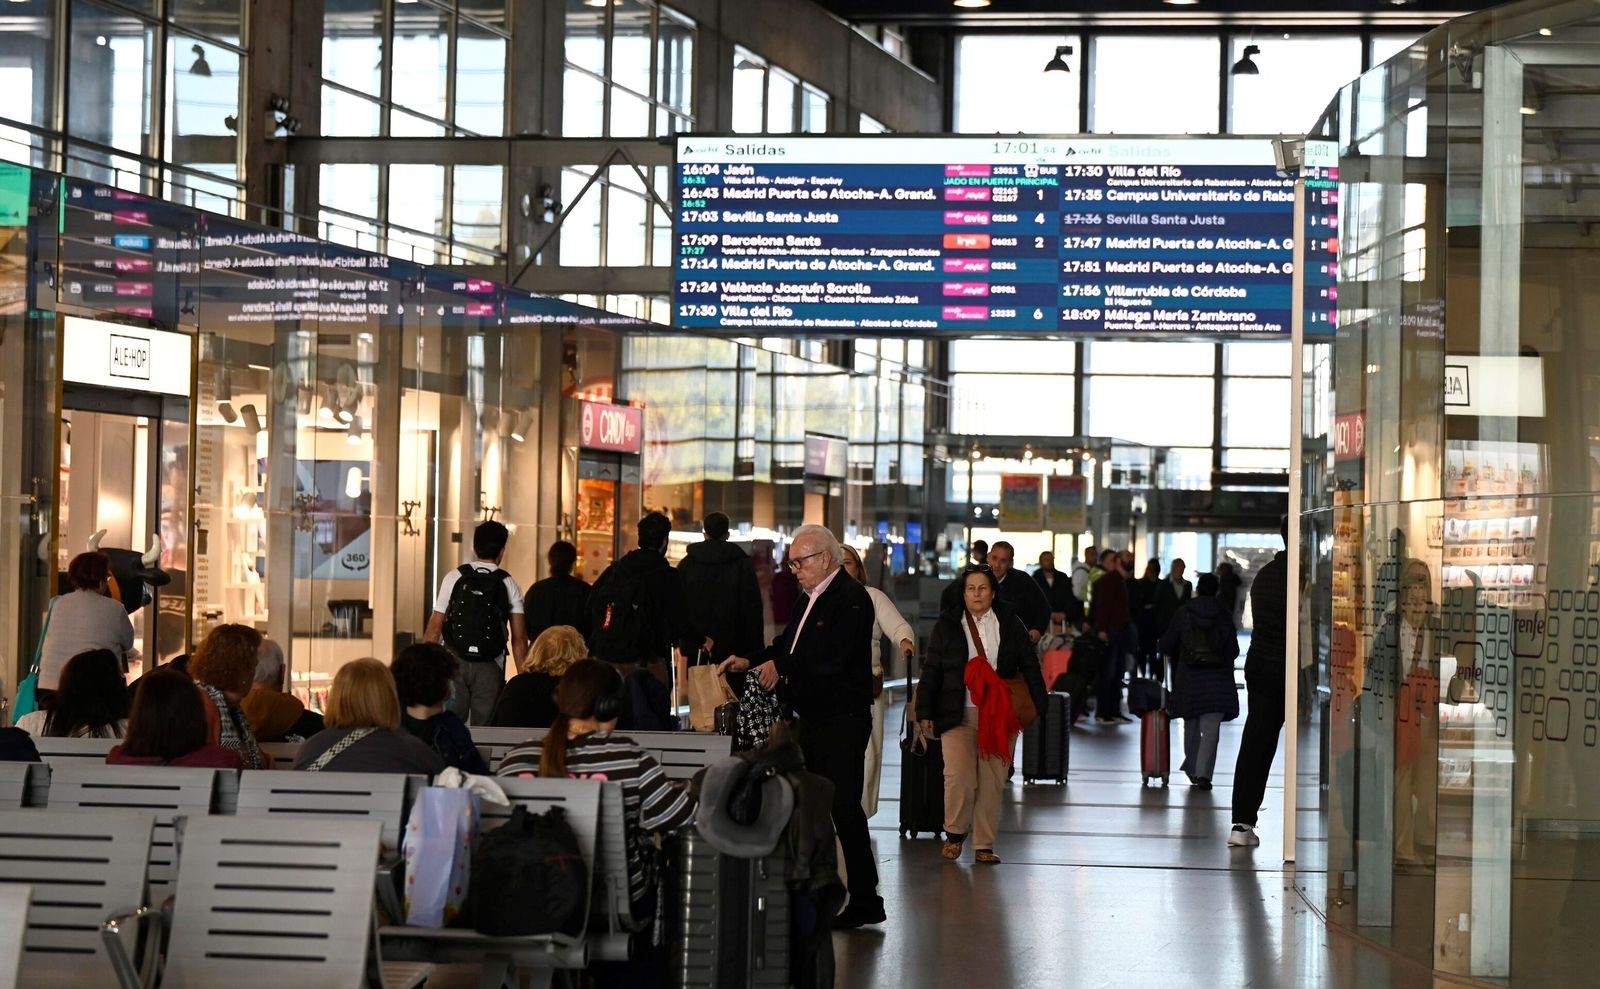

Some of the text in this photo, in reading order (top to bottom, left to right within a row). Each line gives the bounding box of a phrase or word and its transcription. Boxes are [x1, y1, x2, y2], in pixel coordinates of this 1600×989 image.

[726, 144, 786, 156] Salidas
[993, 142, 1038, 154] 17:01
[1108, 145, 1171, 157] Salidas
[683, 164, 720, 175] 16:04
[723, 164, 754, 175] Jaén
[1064, 166, 1181, 177] 17:30 Villa del Río
[1016, 178, 1058, 186] PRINCIPAL
[1106, 178, 1140, 188] Campus
[1140, 178, 1191, 186] Universitario
[1192, 178, 1203, 186] de
[1282, 178, 1293, 186] de
[682, 188, 719, 198] 16:43
[723, 188, 766, 199] Madrid
[768, 188, 810, 199] Puerta
[811, 188, 828, 200] de
[830, 188, 892, 200] Atocha-A.
[894, 188, 936, 200] Grand.
[1036, 190, 1044, 200] 1
[1064, 189, 1103, 200] 17:35
[1106, 190, 1159, 203] Campus
[1161, 190, 1242, 202] Universitario
[1243, 190, 1260, 202] de
[682, 211, 718, 222] 17:03
[722, 211, 764, 222] Sevilla
[766, 211, 802, 222] Santa
[804, 212, 838, 222] Justa
[1034, 212, 1045, 224] 4
[1064, 214, 1226, 226] 17:36 Sevilla Santa Justa
[682, 235, 718, 246] 17:09
[722, 235, 784, 246] Barcelona
[786, 236, 821, 246] Sants
[1034, 237, 1044, 248] 2
[1064, 237, 1102, 248] 17:47
[1106, 237, 1150, 249] Madrid
[1152, 238, 1194, 249] Puerta
[1196, 238, 1214, 250] de
[1215, 238, 1280, 250] Atocha-A.
[680, 258, 718, 270] 17:14
[722, 258, 764, 270] Madrid
[766, 258, 808, 270] Puerta
[810, 258, 826, 270] de
[828, 258, 891, 270] Atocha-A.
[893, 259, 936, 270] Grand.
[1063, 261, 1100, 272] 17:51
[1105, 261, 1150, 272] Madrid
[1152, 262, 1194, 273] Puerta
[1196, 262, 1213, 274] de
[1215, 262, 1280, 274] Atocha-A.
[680, 282, 717, 293] 17:24
[775, 282, 825, 296] Joaquín
[826, 283, 871, 294] Sorolla
[1063, 285, 1247, 298] 17:56 Villarrubia de Córdoba
[1105, 298, 1113, 306] El
[680, 305, 1043, 320] 17:30 Villa del Río 6
[1062, 309, 1256, 322] 18:09 Málaga María Zambrano
[1240, 323, 1264, 331] Santa
[1265, 323, 1282, 331] Ana
[600, 410, 626, 445] CANDY
[347, 554, 365, 562] 360
[1514, 610, 1544, 641] renfe
